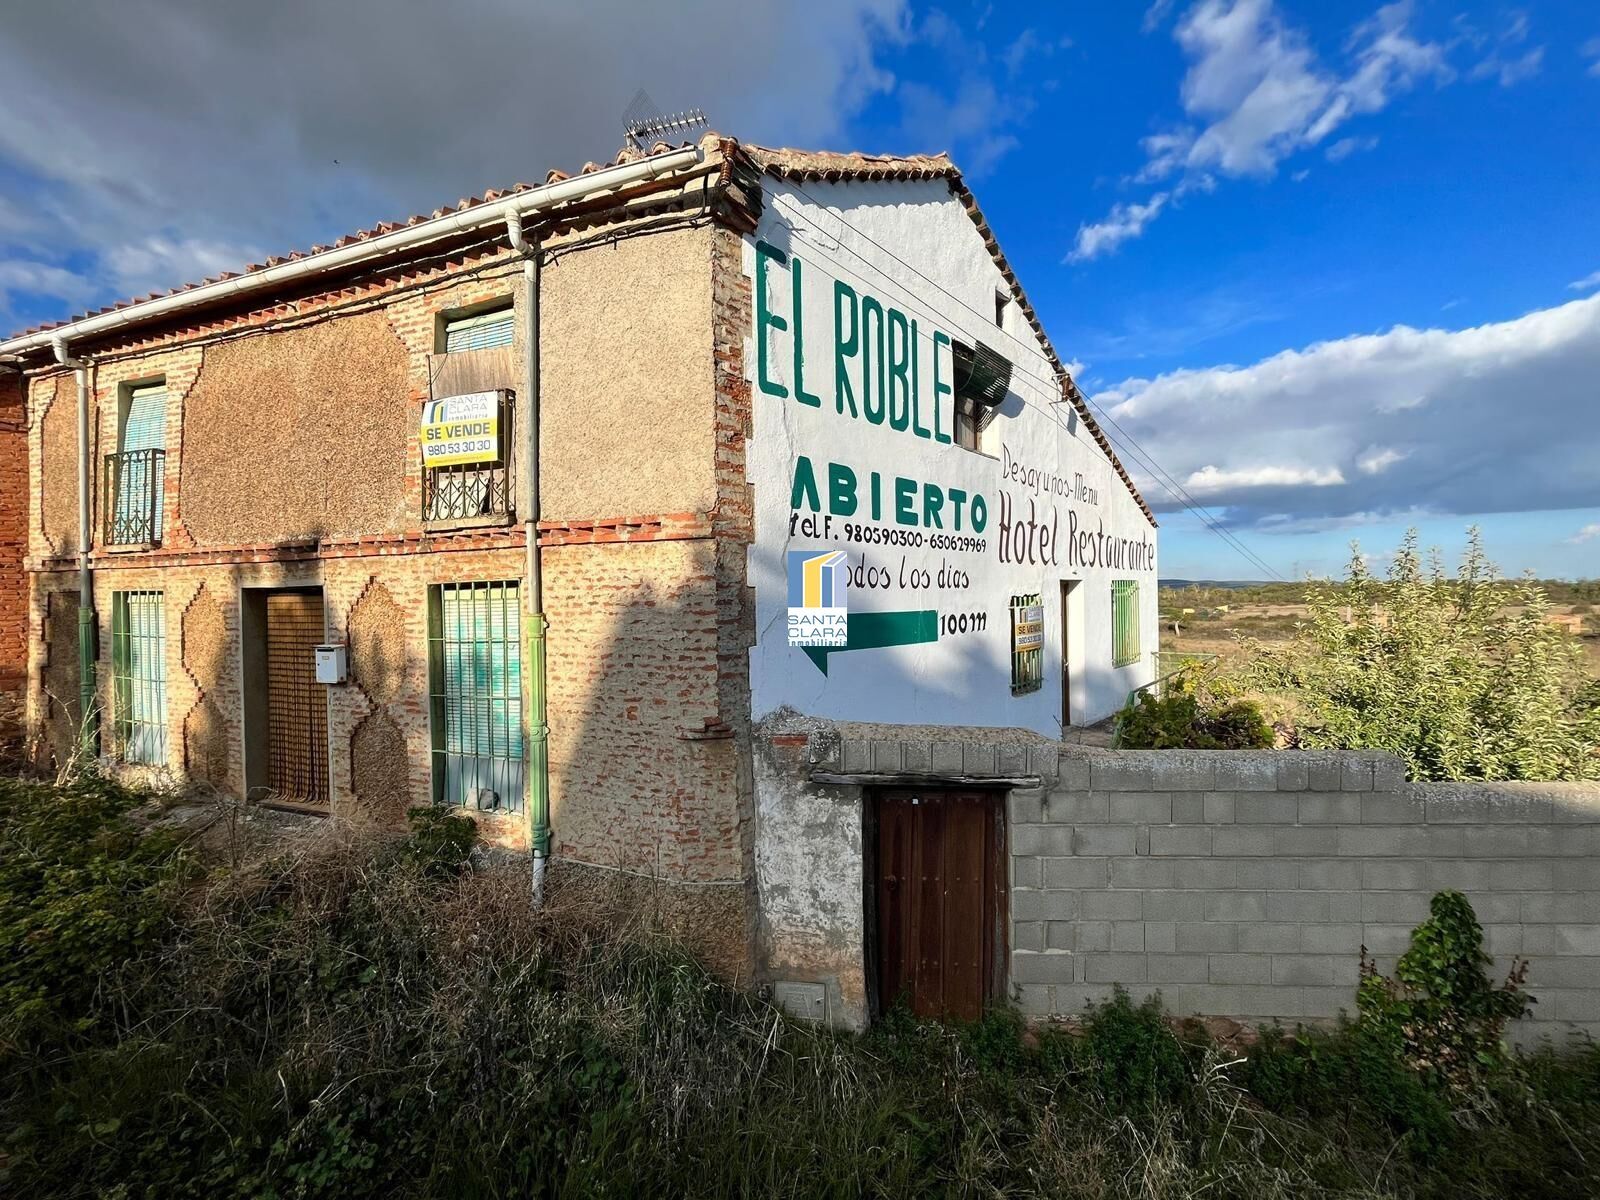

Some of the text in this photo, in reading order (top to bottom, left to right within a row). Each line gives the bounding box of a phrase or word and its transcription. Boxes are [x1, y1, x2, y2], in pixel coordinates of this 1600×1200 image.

[756, 240, 952, 444] EL ROBLE
[449, 394, 487, 404] SANTA
[449, 403, 487, 414] CLARA
[426, 422, 490, 440] SE VENDE
[428, 440, 490, 456] 980 53 30 30
[792, 456, 987, 534] ABIERTO
[998, 489, 1155, 571] Hotel Restaurante
[899, 555, 931, 589] los
